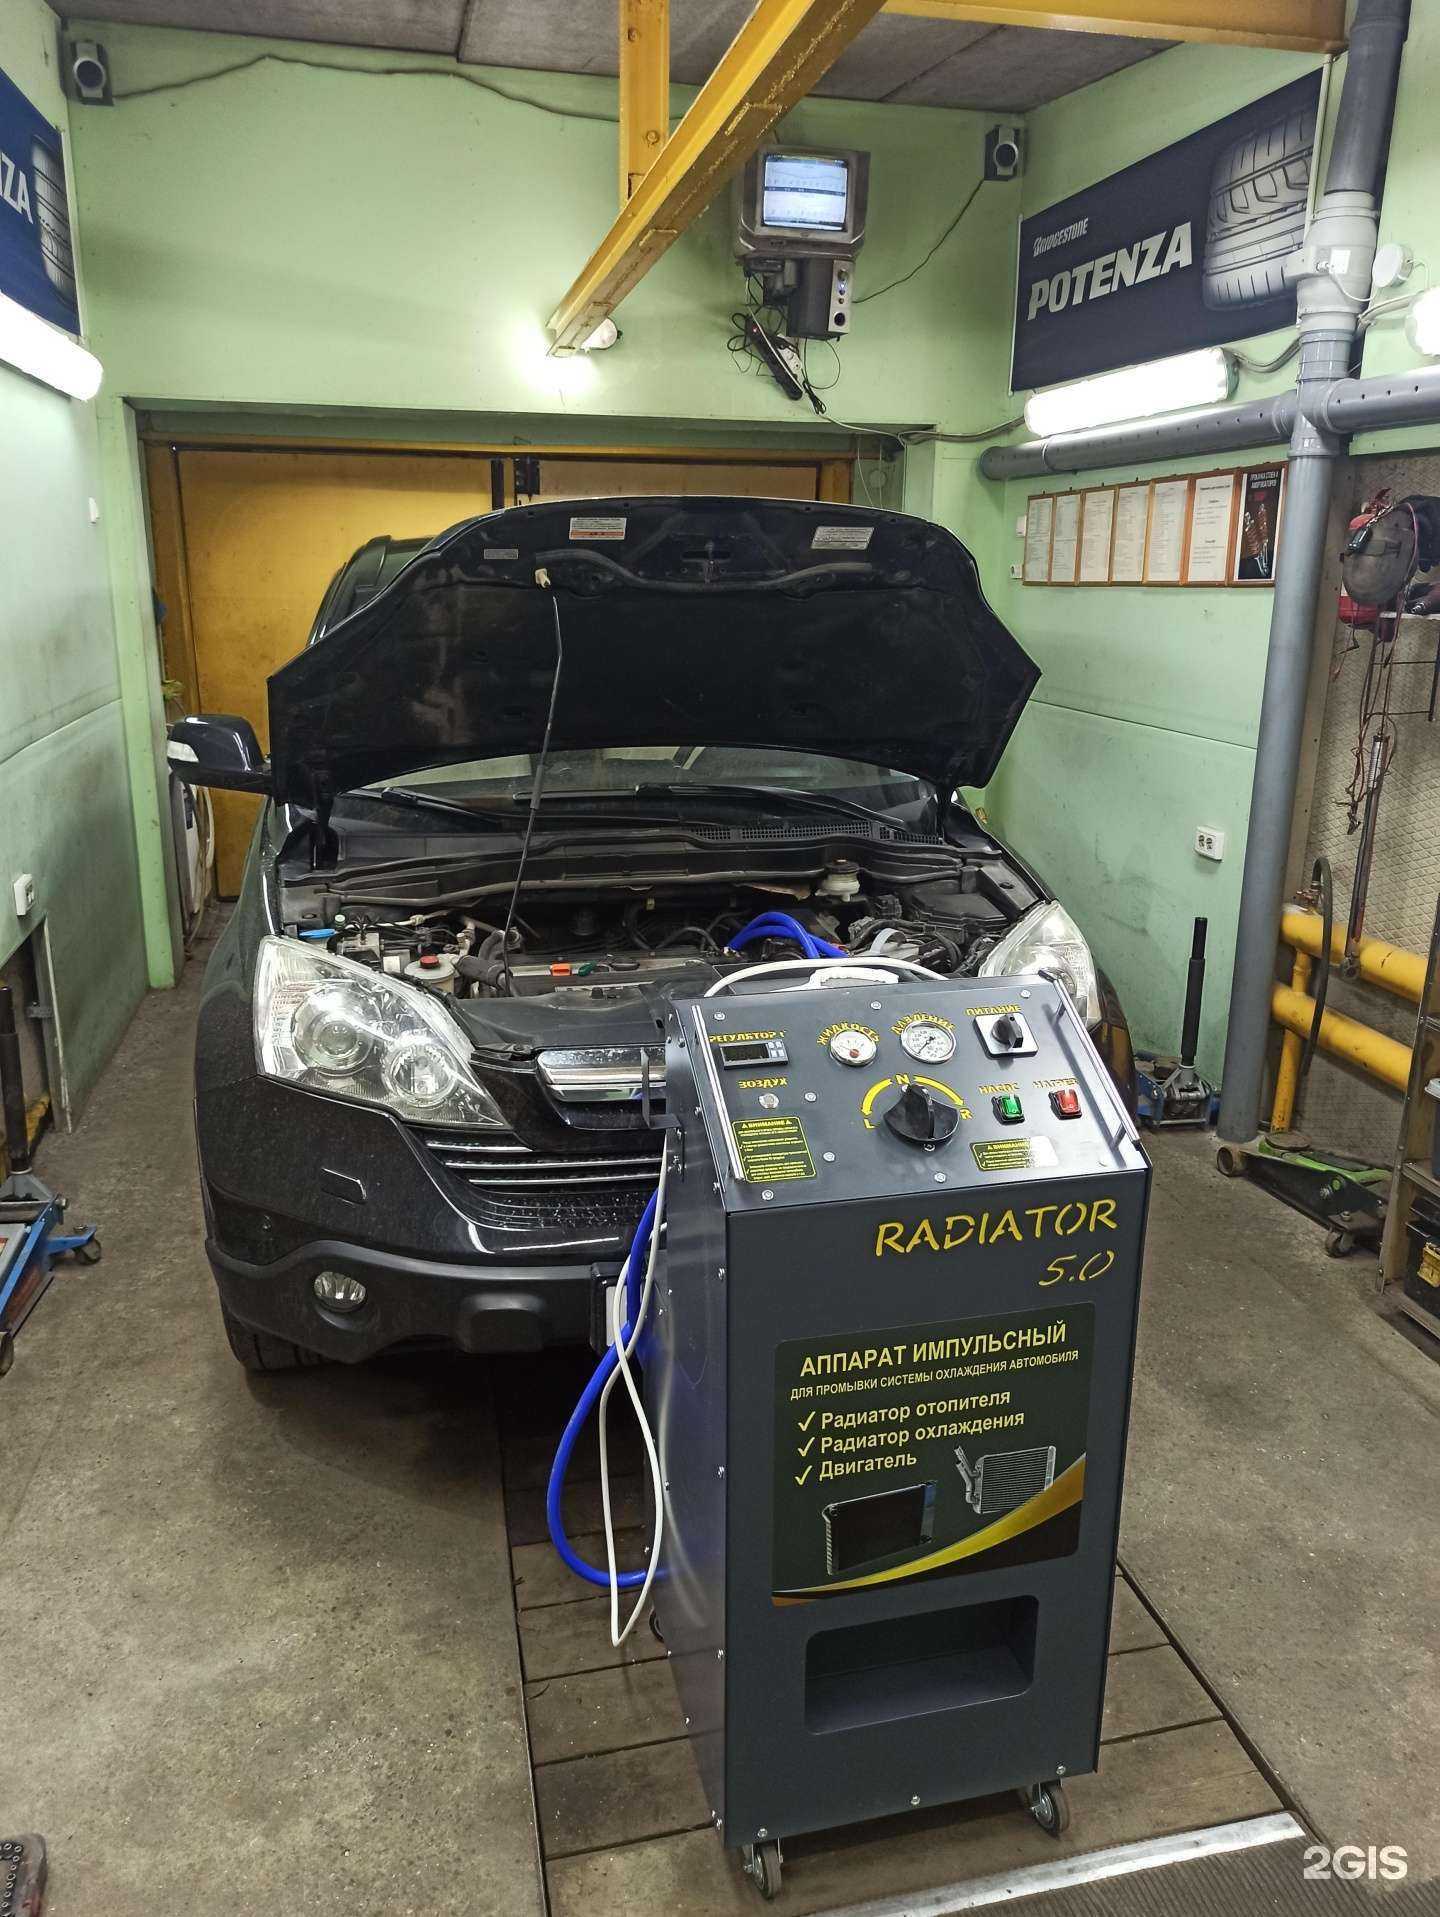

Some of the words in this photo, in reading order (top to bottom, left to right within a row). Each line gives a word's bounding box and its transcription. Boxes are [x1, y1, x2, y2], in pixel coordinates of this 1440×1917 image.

[0, 152, 33, 224] ZA
[1033, 217, 1089, 257] BRIDGESTONE
[1027, 221, 1193, 321] POTENZA
[965, 1004, 1021, 1016] ПИТАНИЕ
[709, 1031, 776, 1043] РЕГУЛЯТОР
[895, 1074, 910, 1085] N
[863, 1118, 875, 1129] L
[960, 1108, 974, 1120] R
[876, 1198, 1118, 1257] RADIATOR
[1038, 1250, 1115, 1286] 5.0
[800, 1345, 906, 1377] АППАРАТ
[912, 1320, 1067, 1363] ИМПУЛЬСНЫЙ
[790, 1386, 814, 1401] ДЛЯ
[816, 1377, 878, 1396] ПРОМЫВКИ
[880, 1371, 933, 1388] СИСТЕМЫ
[935, 1360, 1007, 1382] ОХЛАЖДЕНИЯ
[1009, 1349, 1080, 1370] АВТОМОБИЛЯ
[821, 1404, 911, 1430] Радиатор
[916, 1390, 1011, 1417] отопителя
[820, 1428, 910, 1455] Радиатор
[915, 1412, 1025, 1441] охлаждения
[819, 1452, 917, 1481] Двигатель
